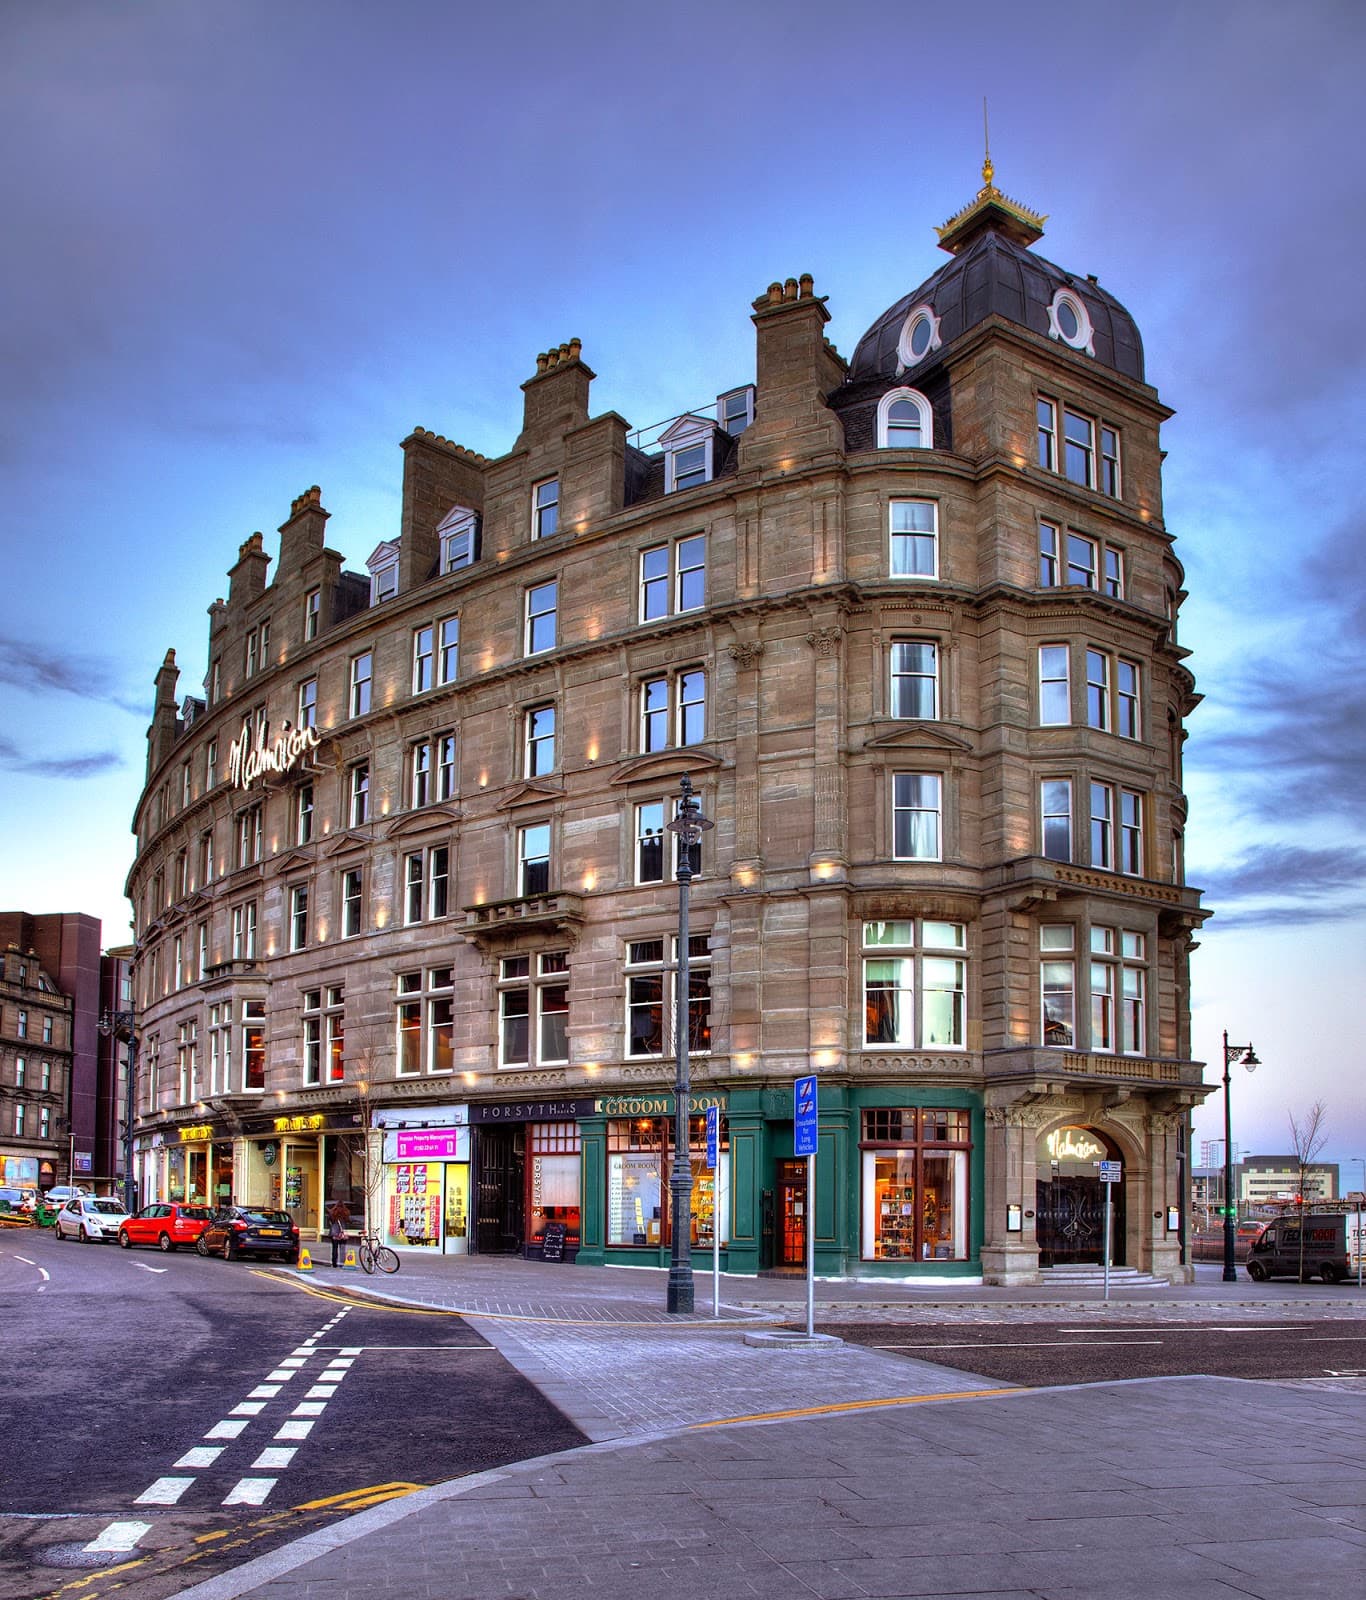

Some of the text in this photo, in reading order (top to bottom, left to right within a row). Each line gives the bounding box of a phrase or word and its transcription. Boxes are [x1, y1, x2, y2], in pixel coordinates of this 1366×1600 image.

[228, 720, 322, 791] Malmaison
[482, 1103, 576, 1118] FORSYTH'S
[605, 1097, 727, 1115] GROOM OOM
[1046, 1129, 1102, 1159] Malmaison
[533, 1157, 541, 1217] FORSYTH'S
